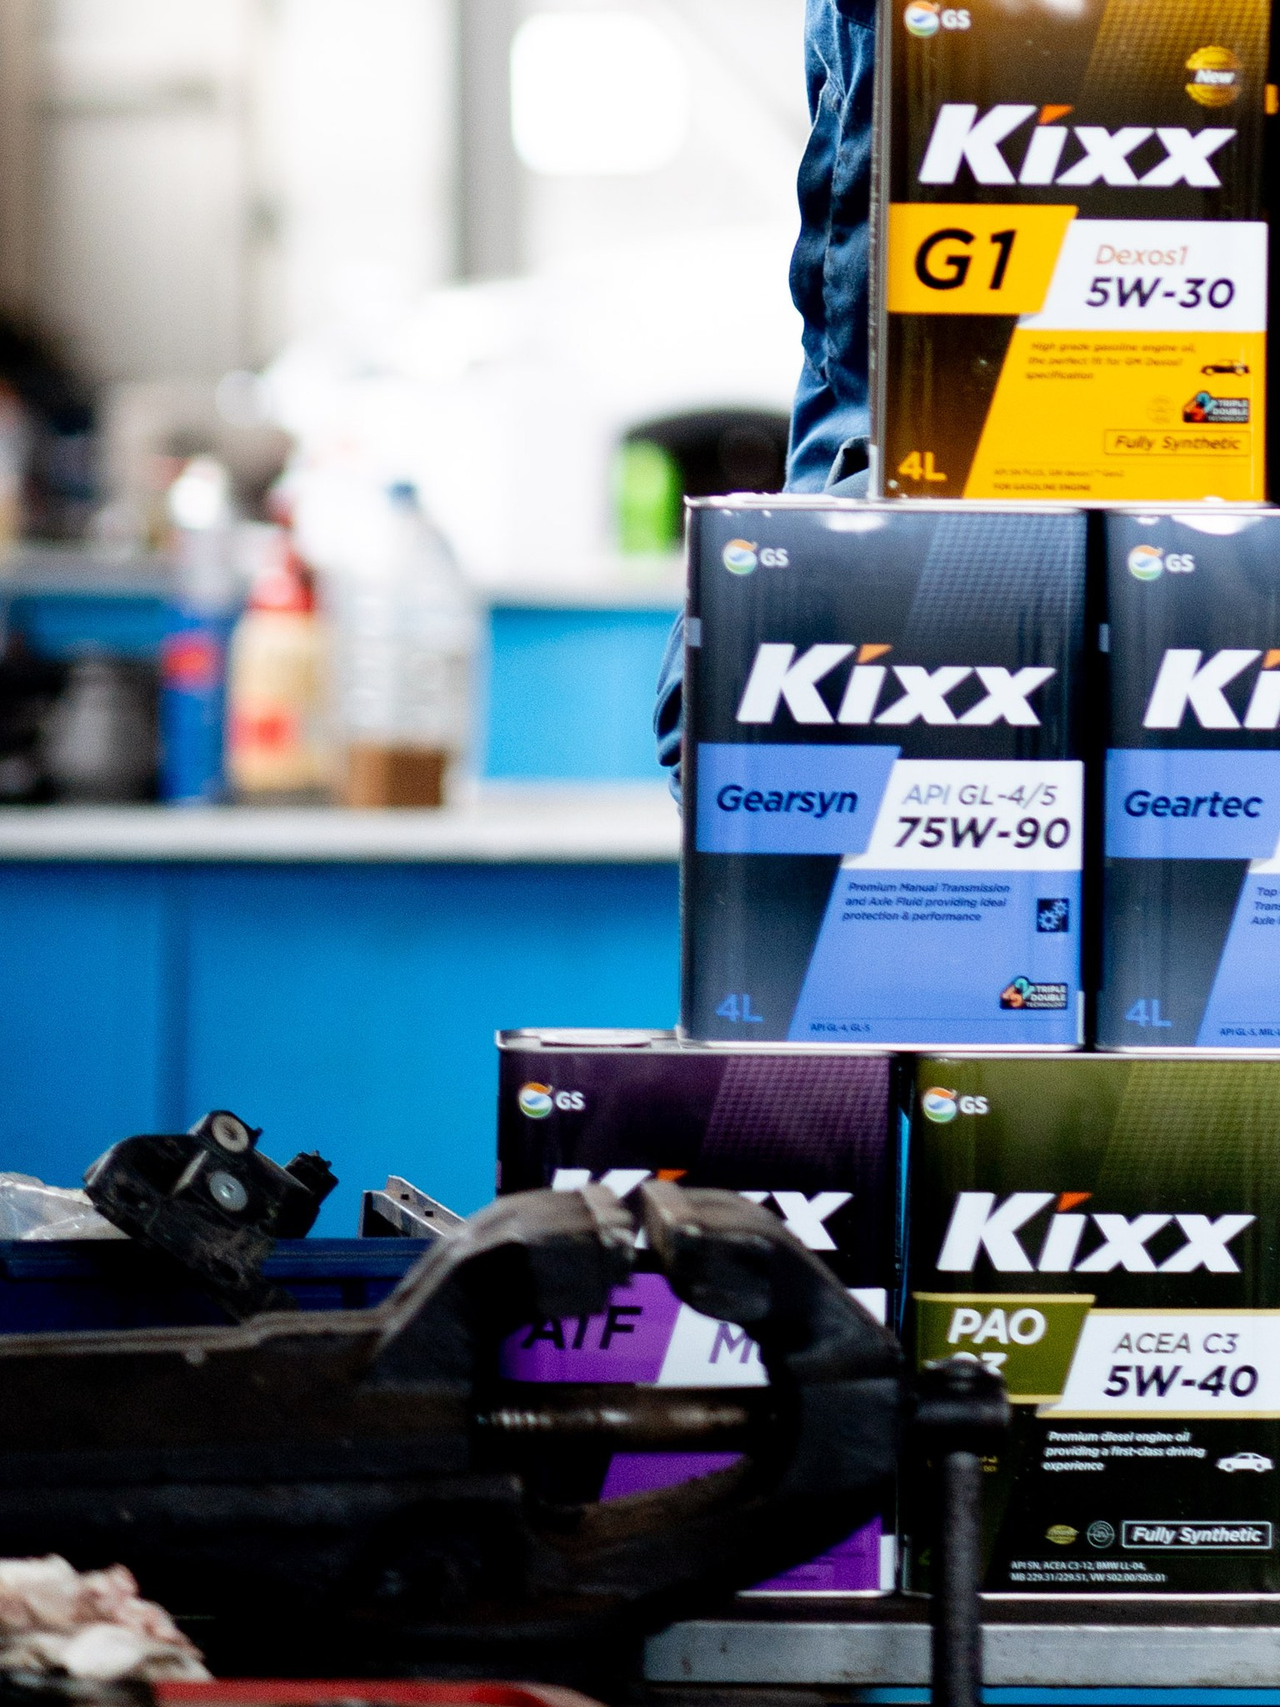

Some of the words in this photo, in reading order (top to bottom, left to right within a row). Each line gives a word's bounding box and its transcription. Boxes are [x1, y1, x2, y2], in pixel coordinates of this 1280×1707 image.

[941, 9, 971, 30] GS
[1195, 69, 1235, 84] New
[918, 104, 1237, 188] Kixx
[914, 228, 1016, 291] G1
[1095, 245, 1188, 266] Dexos1
[1085, 278, 1235, 309] 5W-30
[1114, 435, 1153, 451] Fully
[1162, 436, 1241, 451] Synthetic
[898, 451, 947, 481] 4L
[759, 548, 788, 567] GS
[1165, 554, 1195, 573] GS
[736, 643, 1057, 726] Kixx
[716, 785, 858, 818] Gearsyn
[902, 785, 951, 805] API
[958, 783, 1058, 808] GL-4/5
[1124, 791, 1263, 818] Geartec
[894, 817, 1070, 849] 75W-90
[1257, 887, 1278, 897] Top
[1251, 916, 1276, 926] Axle
[714, 994, 763, 1023] 4L
[1124, 999, 1172, 1027] 4L
[555, 1092, 584, 1110] GS
[960, 1096, 988, 1115] GS
[936, 1192, 1257, 1273] Kixx
[947, 1308, 1046, 1345] PAO
[1113, 1333, 1191, 1354] ACEA
[1202, 1333, 1240, 1354] C3
[1103, 1365, 1259, 1398] 5W-40
[1049, 1432, 1098, 1442] Premium
[1101, 1432, 1133, 1442] diesel
[1136, 1433, 1174, 1444] engine
[1176, 1432, 1190, 1442] oil
[1045, 1446, 1099, 1458] providing
[1110, 1446, 1164, 1457] first-class
[1166, 1446, 1206, 1458] driving
[1043, 1462, 1105, 1472] experience
[1133, 1526, 1175, 1544] Fully
[1179, 1526, 1262, 1544] Synthetic
